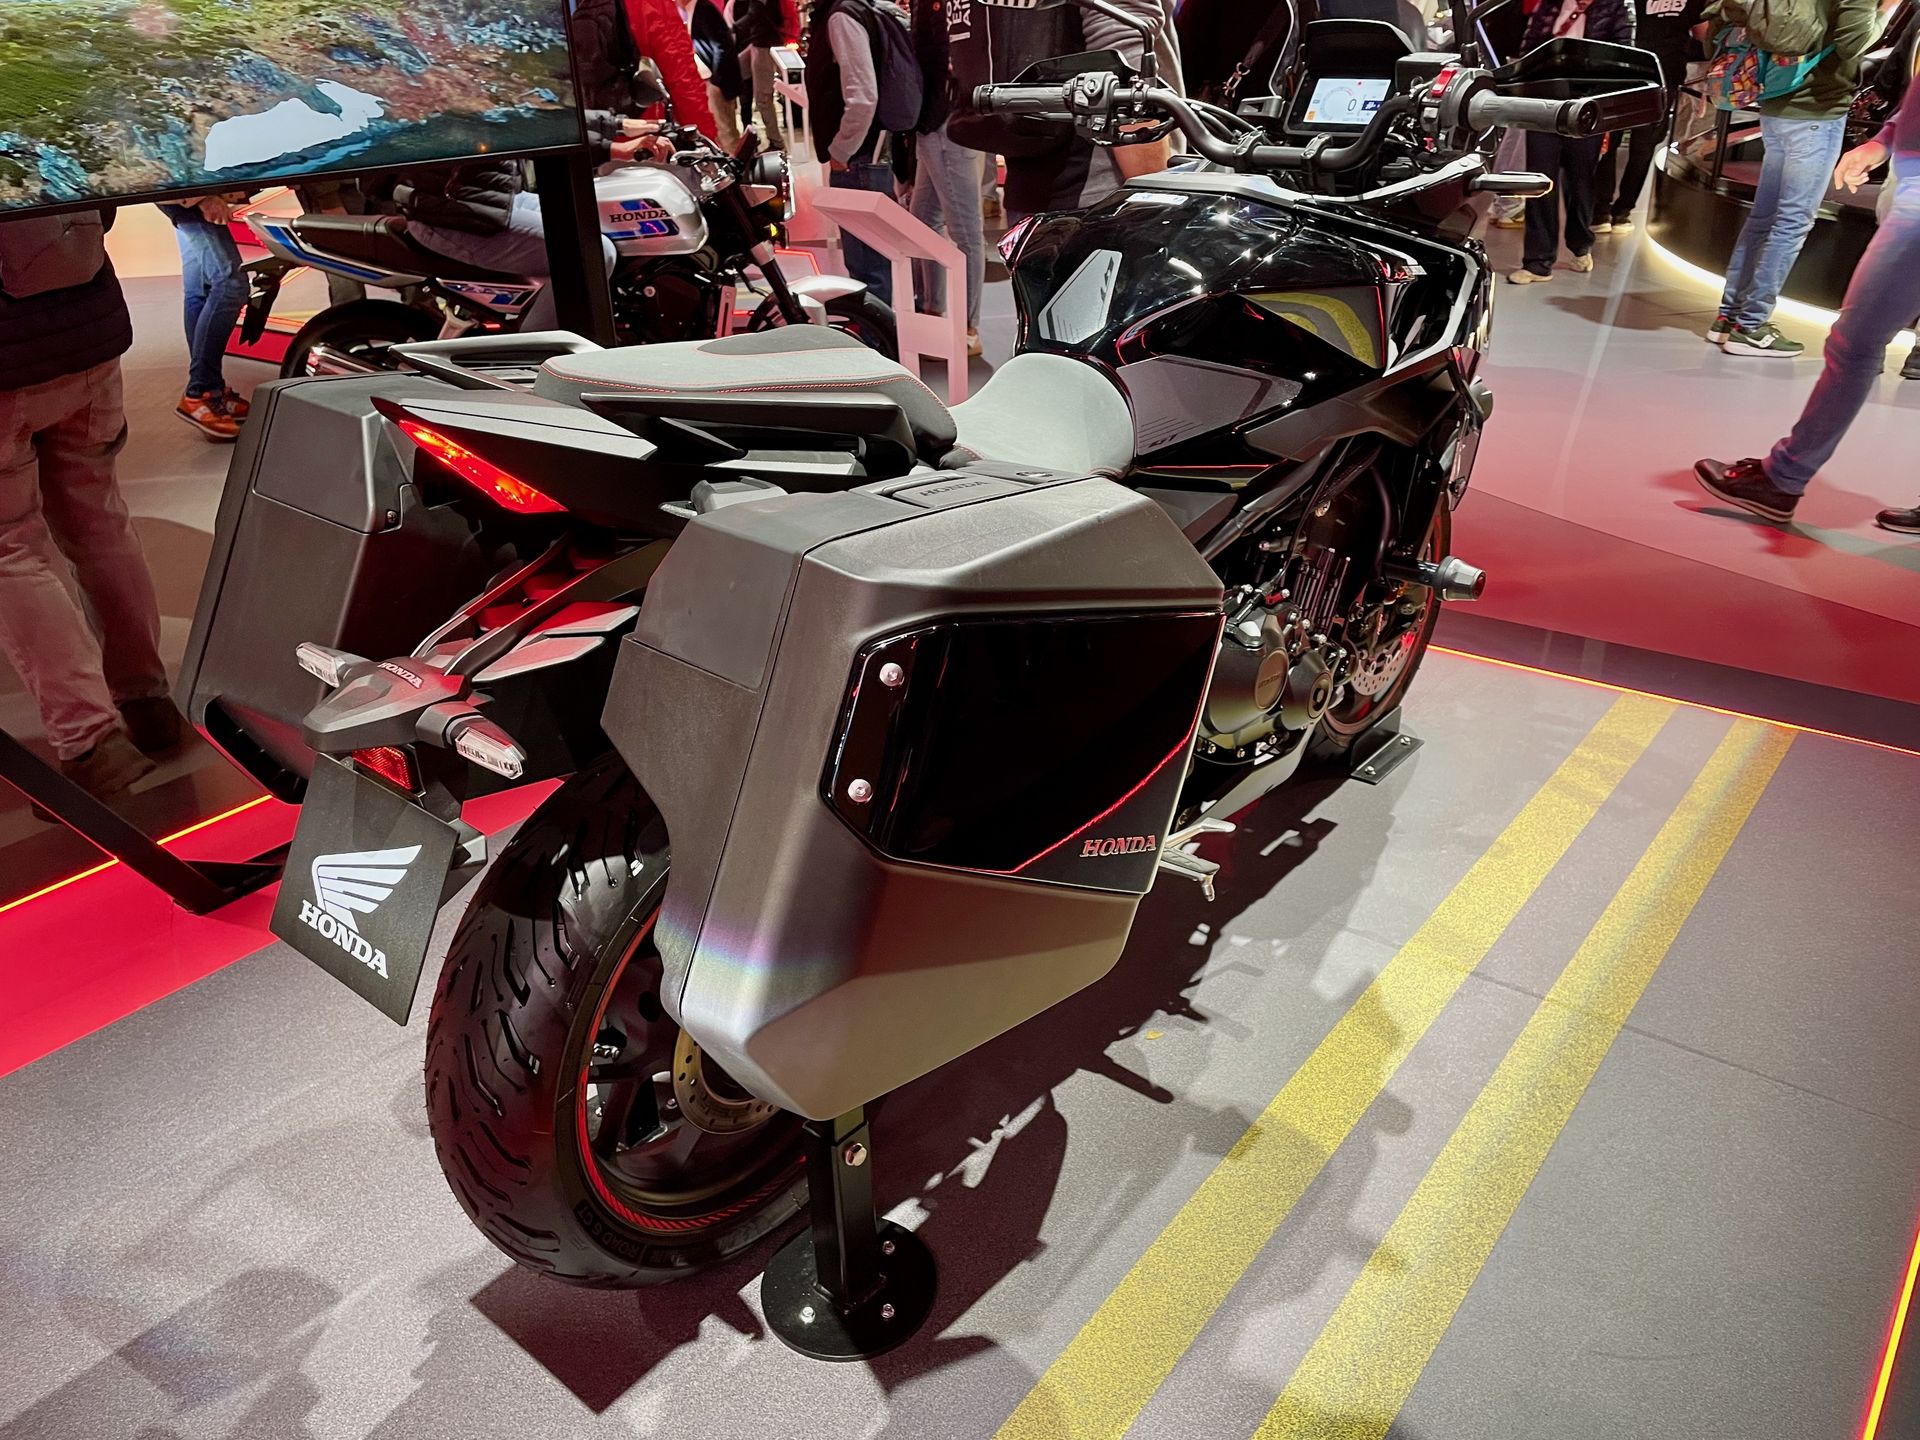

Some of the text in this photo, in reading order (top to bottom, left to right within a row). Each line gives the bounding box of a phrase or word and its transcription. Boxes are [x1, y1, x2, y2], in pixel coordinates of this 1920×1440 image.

[1347, 98, 1357, 111] 0
[609, 209, 671, 223] HONDA
[920, 481, 991, 496] HONDA
[376, 662, 423, 689] HONDA
[1079, 835, 1157, 857] HONDA
[298, 899, 388, 980] HONDA
[601, 1231, 640, 1259] ROAD
